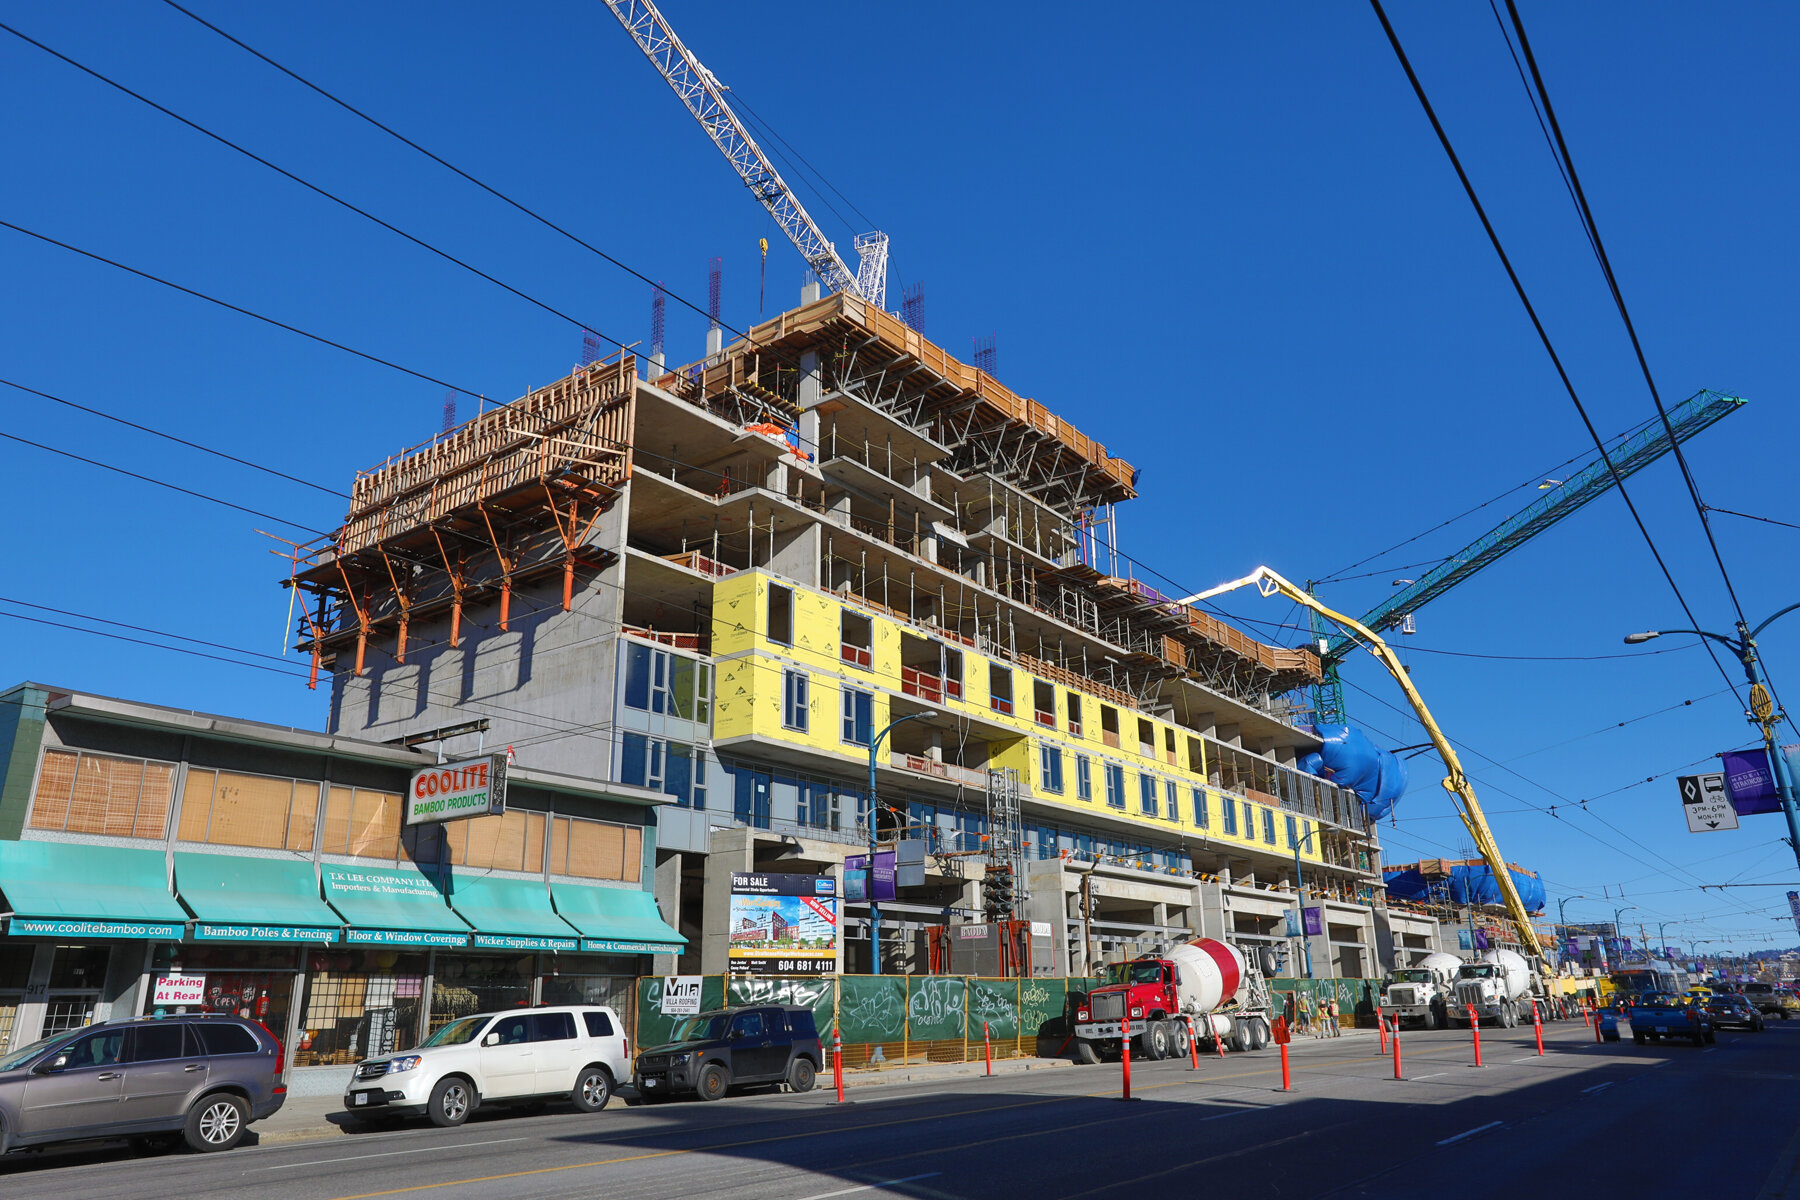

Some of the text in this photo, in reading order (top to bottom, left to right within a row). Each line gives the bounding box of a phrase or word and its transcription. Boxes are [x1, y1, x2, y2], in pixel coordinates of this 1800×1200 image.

[415, 762, 489, 799] COOLITE
[414, 793, 487, 815] BAMBOO PRODUCTS
[347, 873, 364, 882] LEE
[366, 875, 414, 887] COMPANY
[733, 877, 768, 887] FOR SALE
[332, 882, 371, 893] Importers
[373, 884, 381, 893] &
[818, 907, 834, 921] SELLING
[204, 926, 333, 941] Bamboo Poles & Fencing
[348, 931, 466, 945] Floor & Window Coverings
[477, 936, 575, 949] Wicker Supplies & Repairs
[587, 941, 678, 954] Home & Commercial Furnishings
[778, 961, 833, 971] 604 681 4111
[158, 977, 203, 988] Parking
[666, 978, 699, 996] Villa
[27, 984, 46, 995] 917
[156, 992, 201, 1000] At Rear
